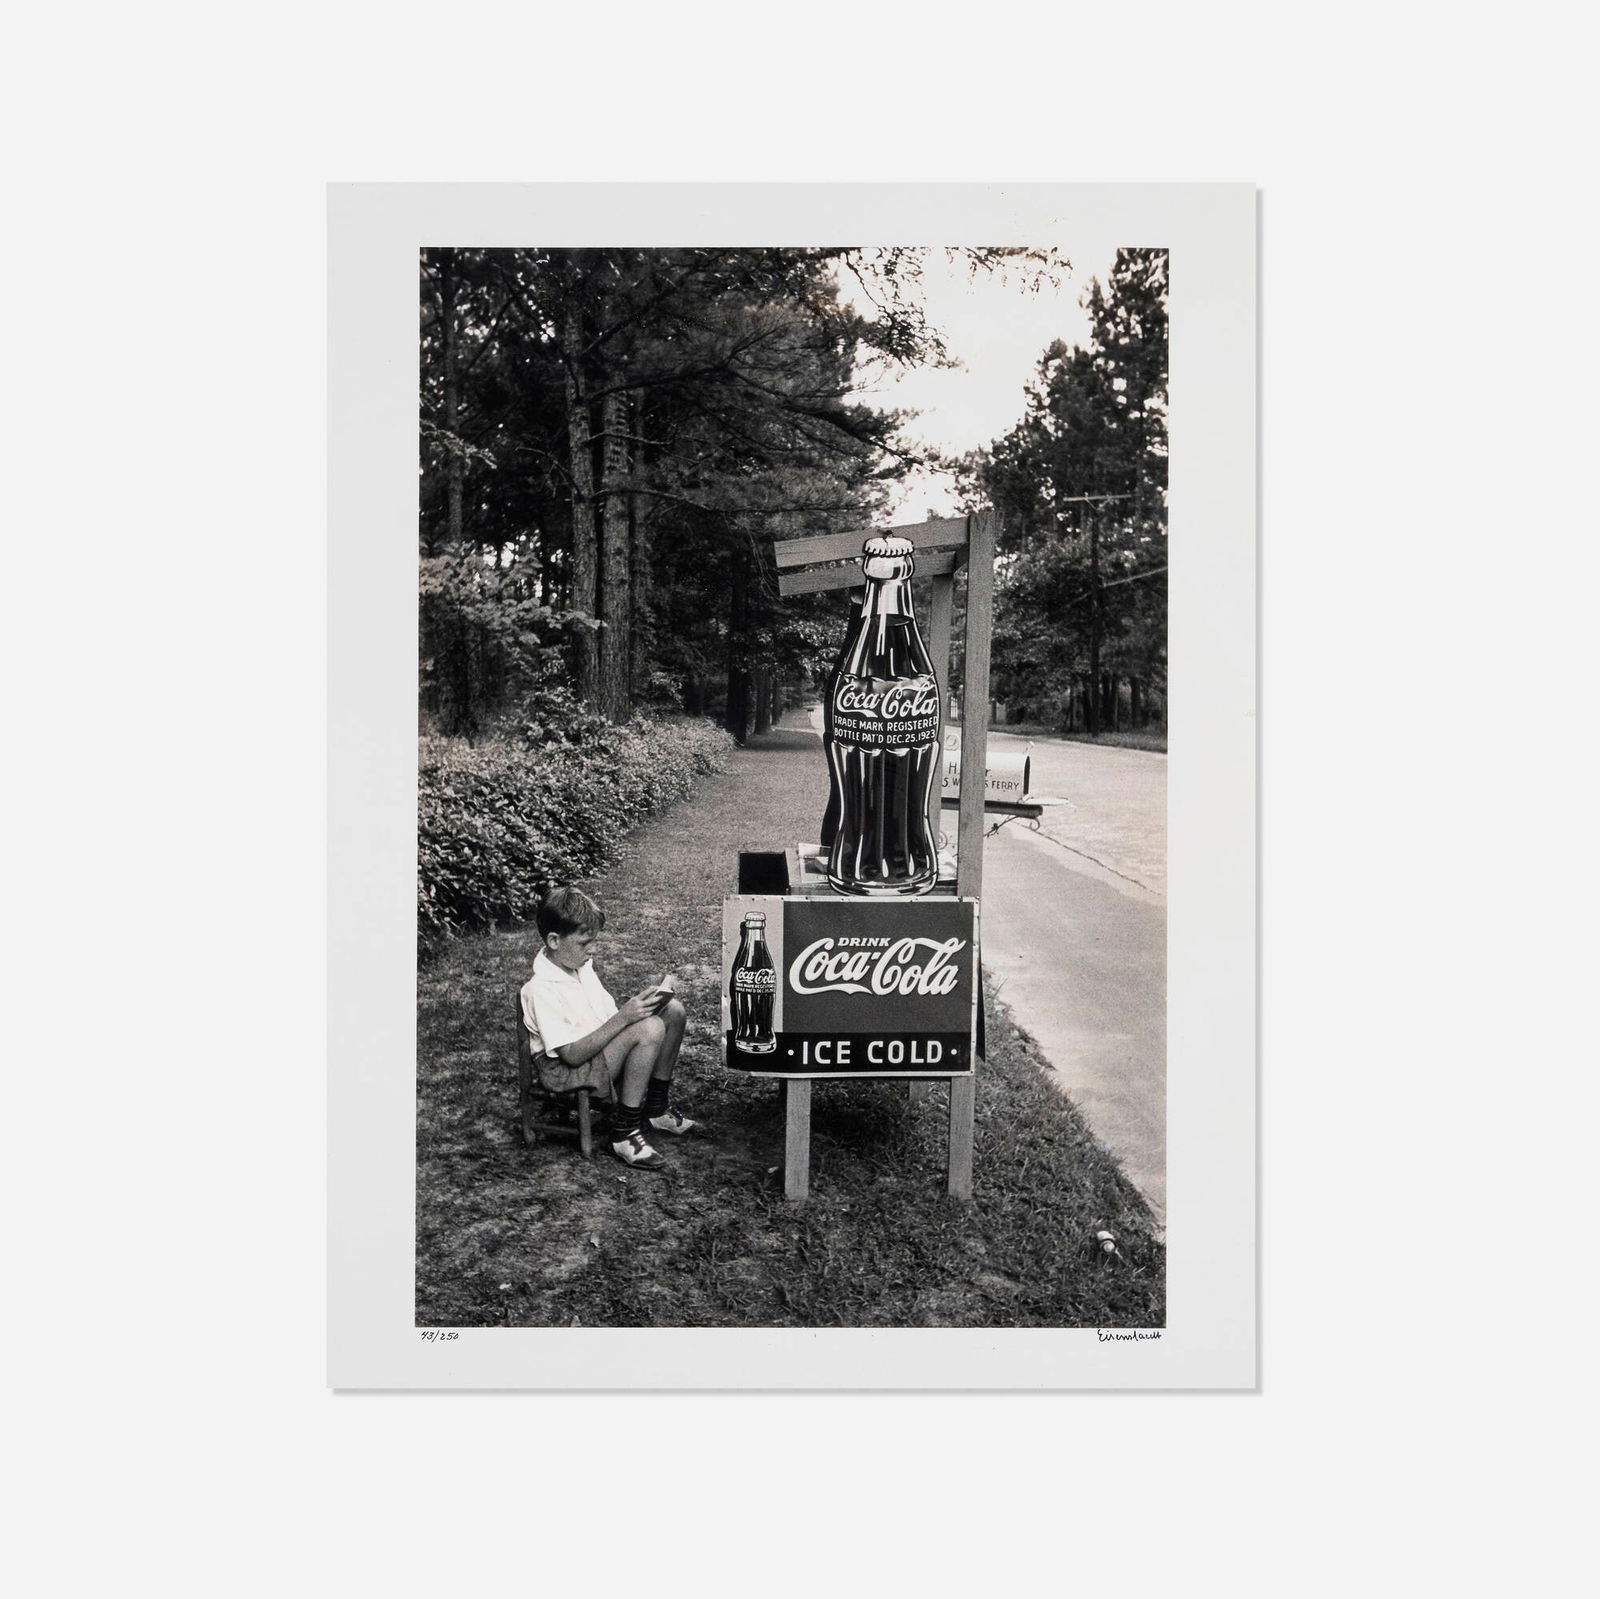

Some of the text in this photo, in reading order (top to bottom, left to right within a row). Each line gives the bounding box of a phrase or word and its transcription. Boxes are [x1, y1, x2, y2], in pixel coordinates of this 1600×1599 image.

[836, 682, 938, 719] Coca-Cola
[835, 715, 938, 732] TRADE MARK REGISTERED
[834, 728, 860, 741] BOTTLE
[861, 733, 884, 743] PAT'D
[991, 780, 1019, 791] FERRY
[837, 937, 891, 947] DRINK
[789, 936, 966, 996] Coca-Cola
[736, 967, 776, 984] Coca-Cola
[802, 1040, 943, 1065] ICE COLD
[421, 1329, 459, 1343] 43/250
